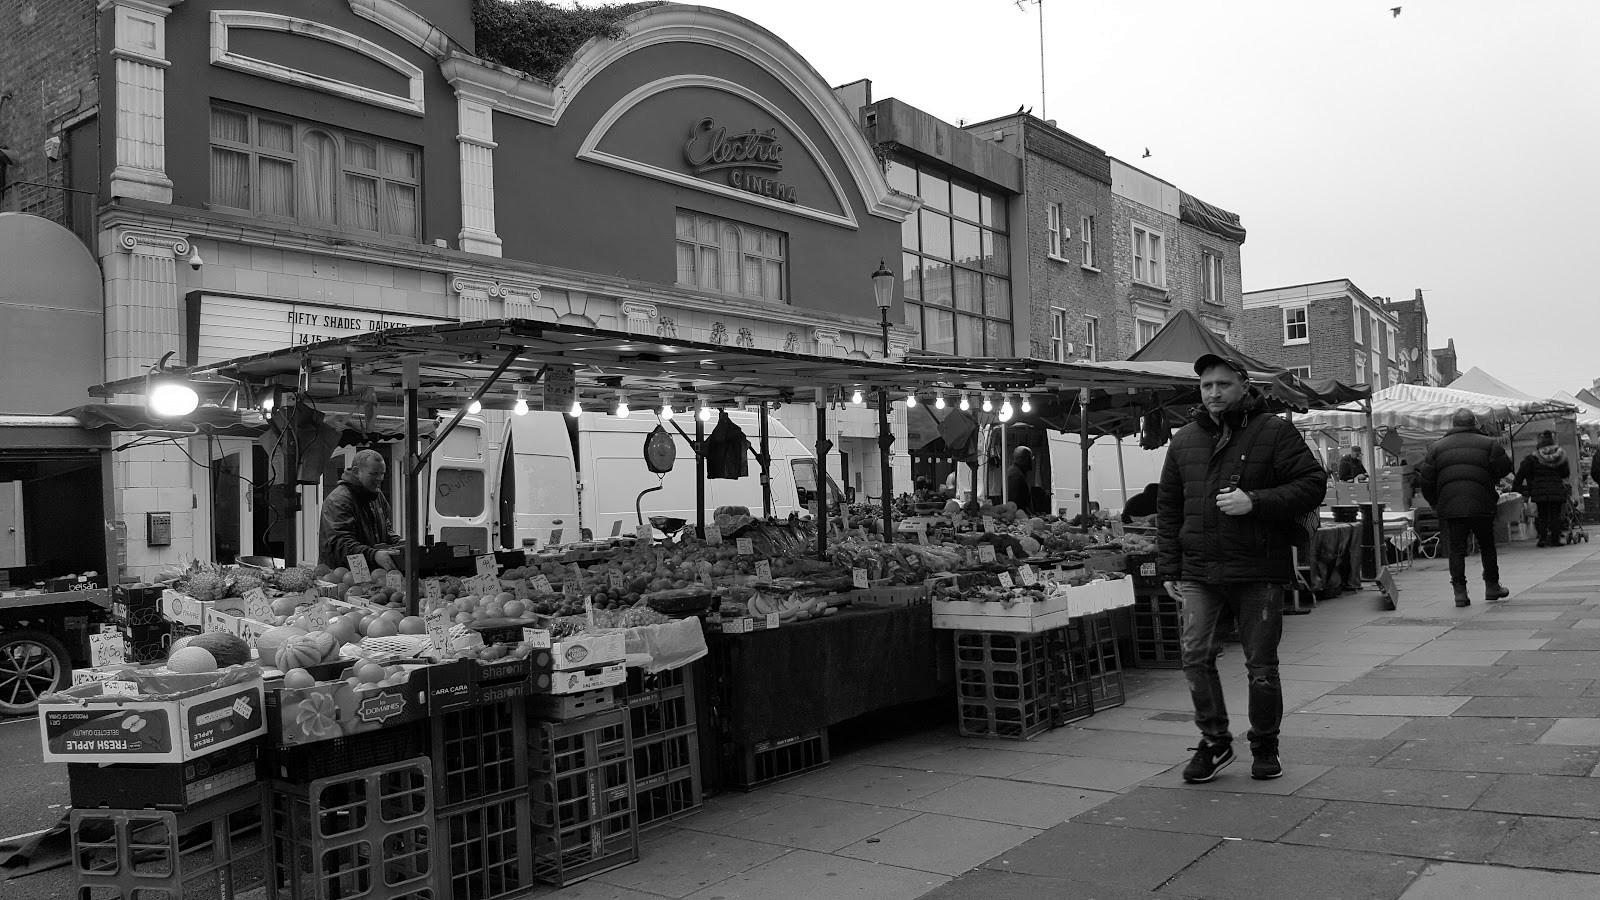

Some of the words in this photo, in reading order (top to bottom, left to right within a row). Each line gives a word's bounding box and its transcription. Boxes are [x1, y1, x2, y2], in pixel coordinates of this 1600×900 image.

[684, 116, 783, 170] Electric
[729, 169, 798, 203] CINEMA
[287, 311, 318, 326] FIFTY
[323, 315, 362, 331] SHADES
[439, 472, 475, 497] Devlin
[68, 581, 98, 592] belsán
[431, 687, 450, 696] CARA
[449, 684, 469, 693] CARA
[365, 702, 400, 716] DOMAINES
[193, 728, 214, 740] APPLE
[66, 740, 95, 750] APPLE
[97, 740, 127, 750] FRESH
[193, 736, 214, 748] FRESH
